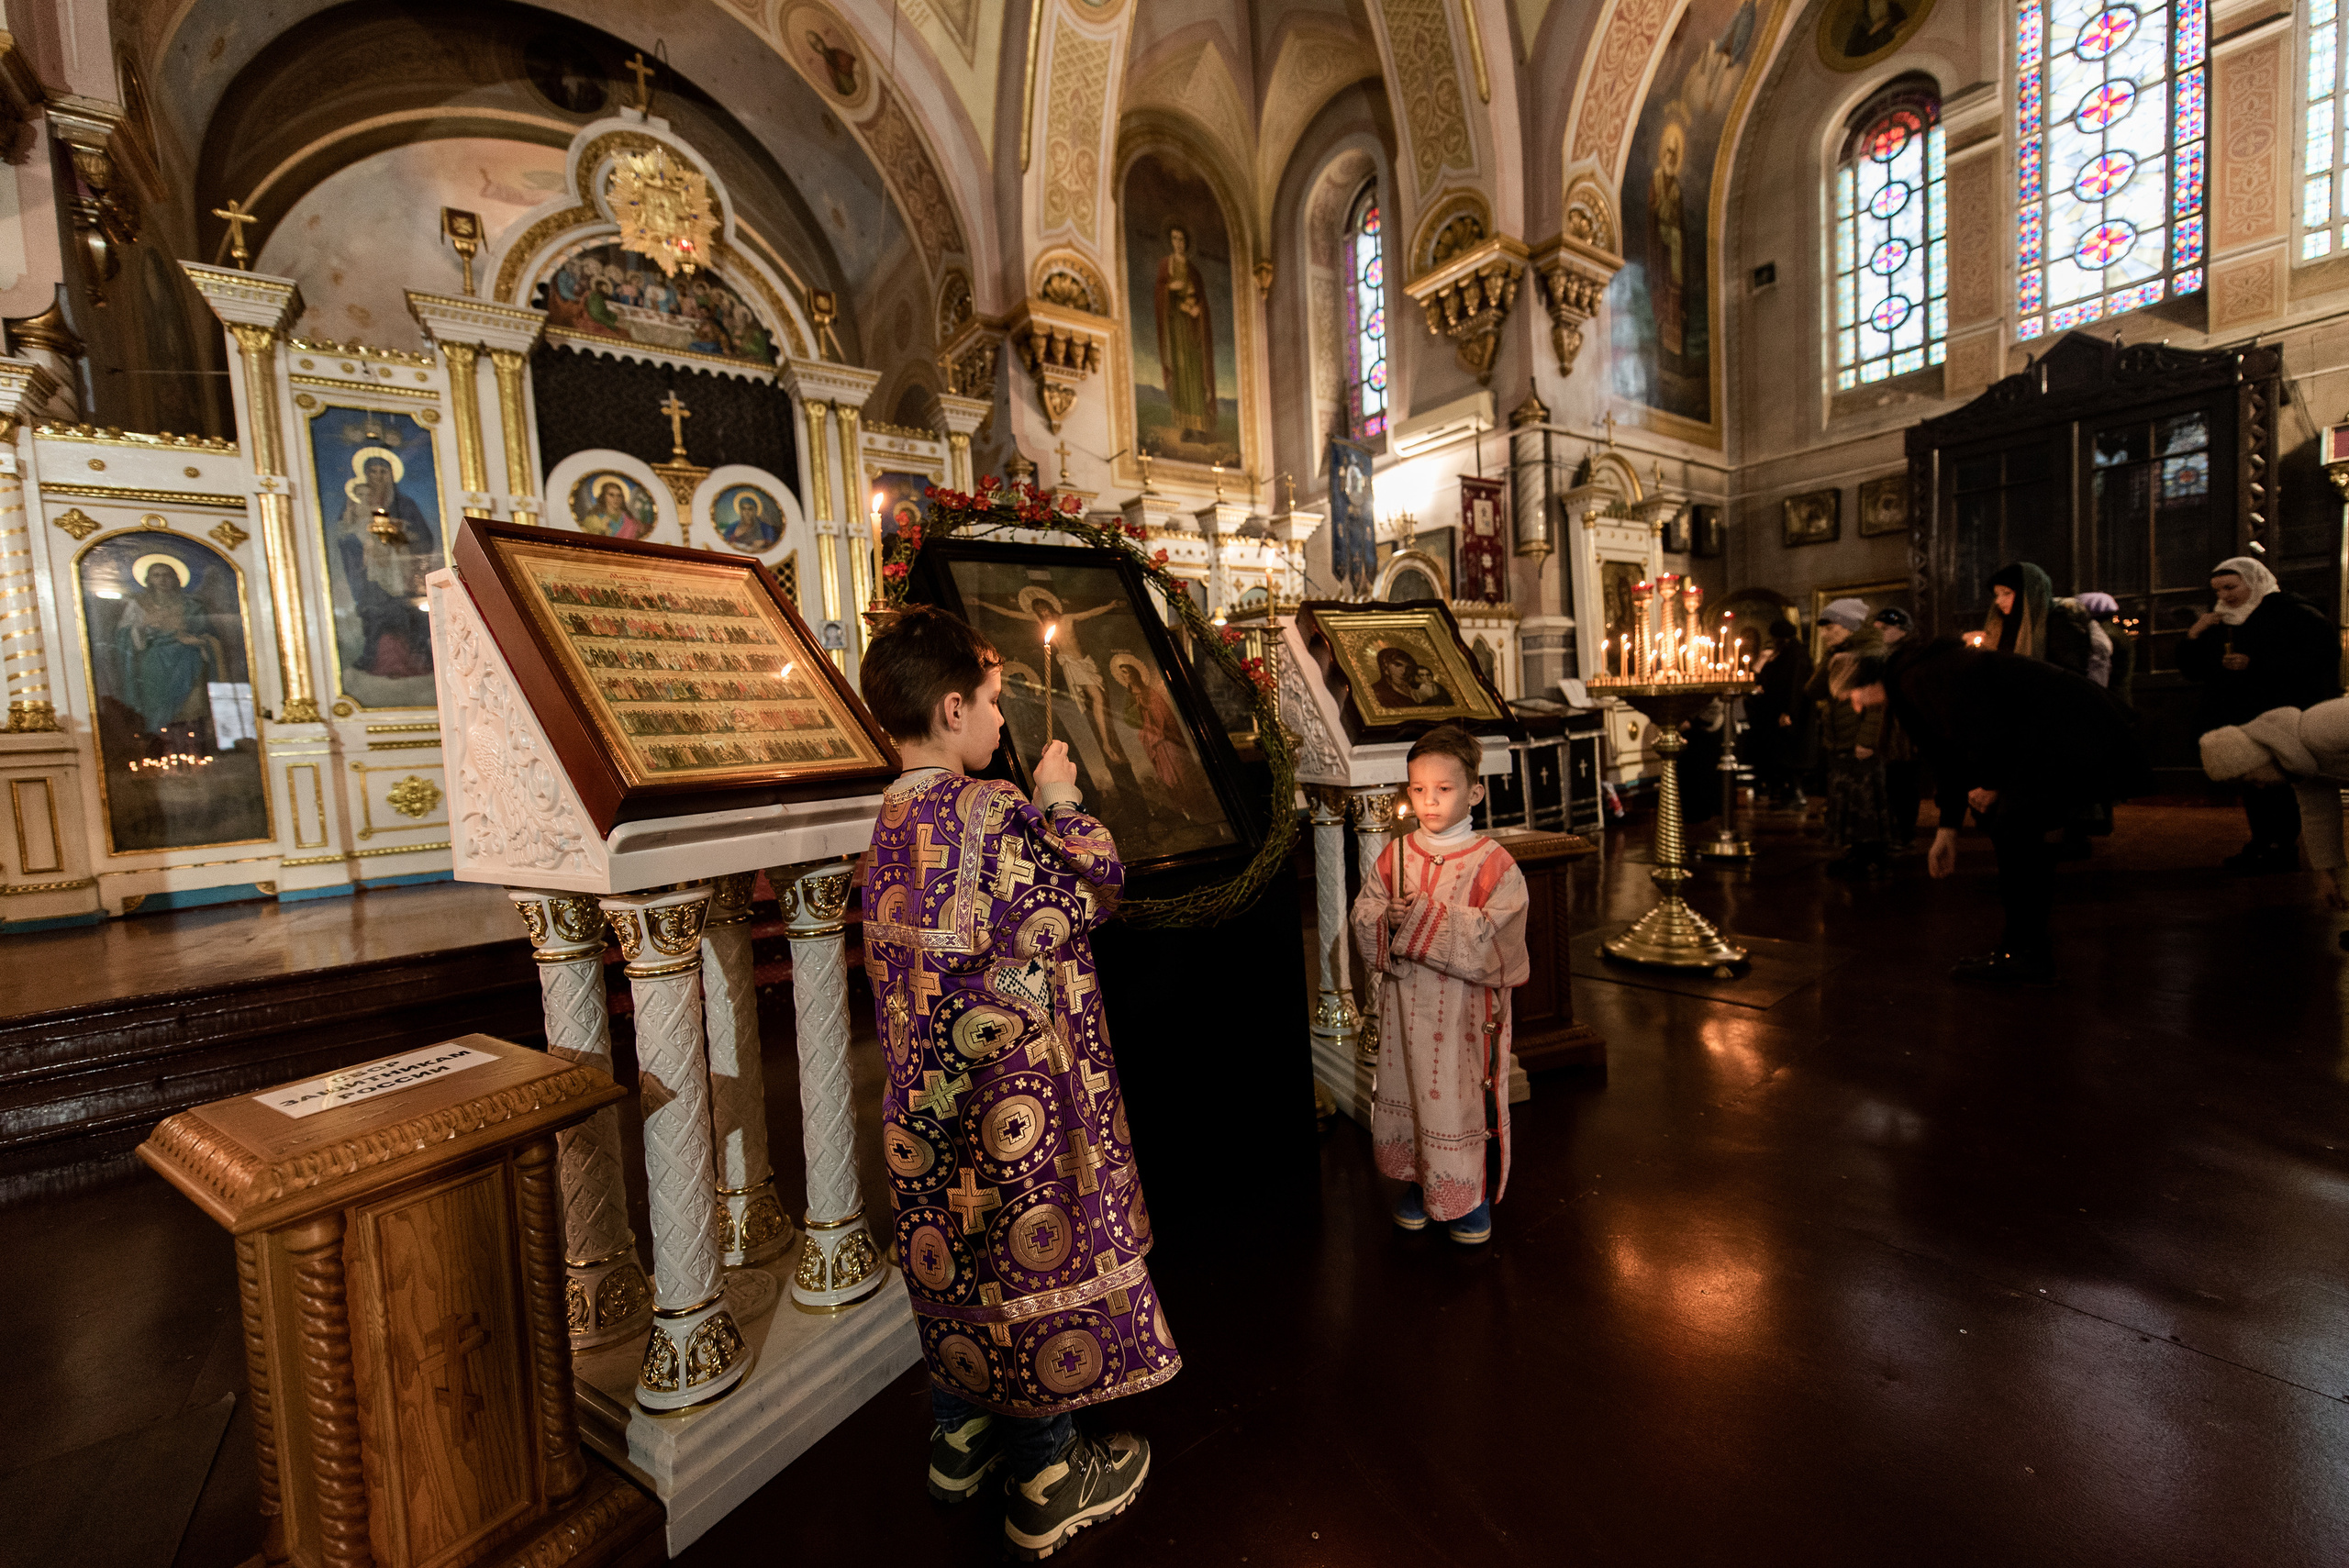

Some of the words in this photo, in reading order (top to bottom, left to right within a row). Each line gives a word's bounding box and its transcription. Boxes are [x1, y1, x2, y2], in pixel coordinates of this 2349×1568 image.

[279, 1051, 472, 1106] ЗАЩИТНИКАМ
[332, 1061, 399, 1083] СБОР
[338, 1066, 451, 1099] РОССИИ
